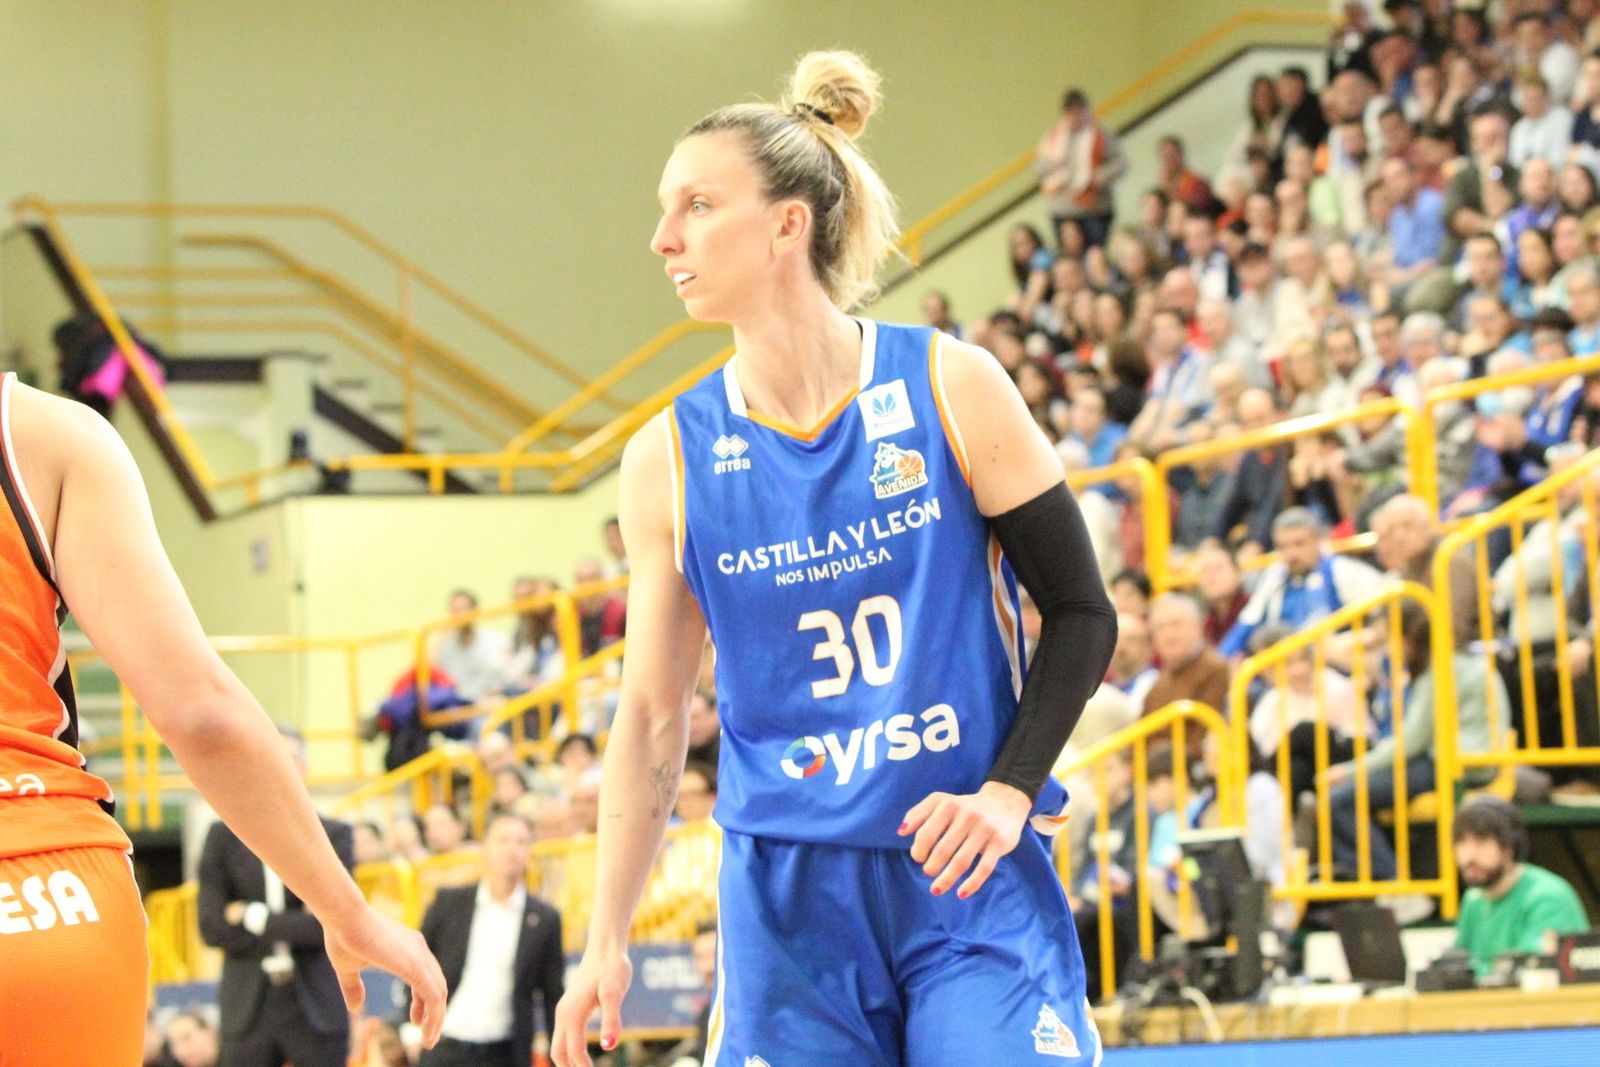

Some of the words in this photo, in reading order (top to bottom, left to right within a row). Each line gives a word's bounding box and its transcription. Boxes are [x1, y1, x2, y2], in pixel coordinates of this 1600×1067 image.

[877, 475, 926, 496] AVENIDA
[717, 530, 848, 575] CASTILLA
[846, 521, 866, 550] Y
[871, 498, 941, 540] LEÓN
[775, 568, 805, 587] NOS
[797, 595, 902, 699] 30
